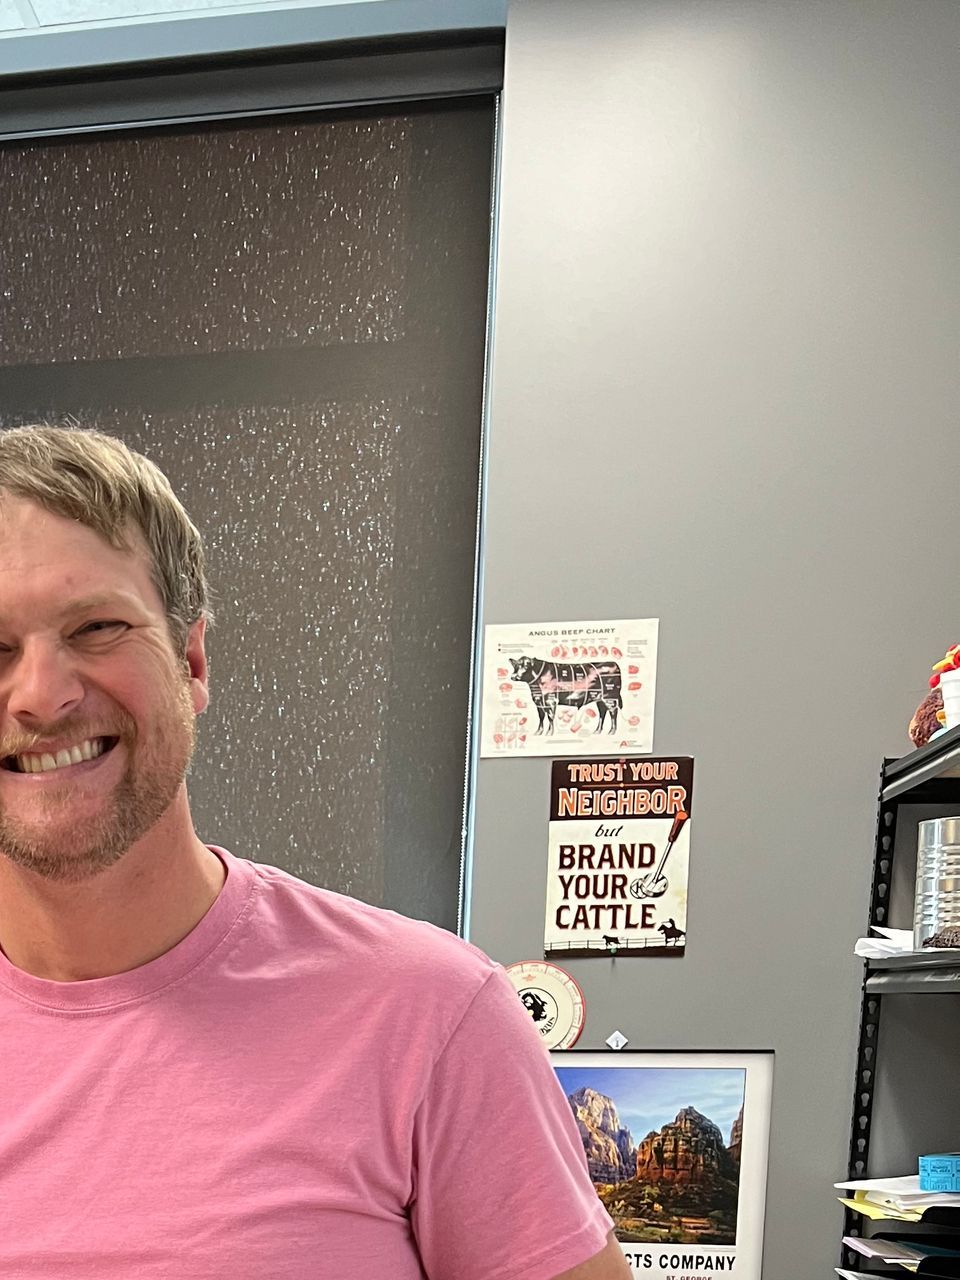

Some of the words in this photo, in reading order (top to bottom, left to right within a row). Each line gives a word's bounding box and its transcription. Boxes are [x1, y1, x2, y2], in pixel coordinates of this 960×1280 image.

[568, 763, 626, 782] TRUST
[629, 762, 678, 781] YOUR
[558, 786, 687, 816] NEIGHBOR
[595, 824, 623, 838] but
[558, 843, 656, 870] BRAND
[558, 875, 628, 900] YOUR
[556, 904, 657, 930] CATTLE
[659, 1254, 736, 1270] COMPANY
